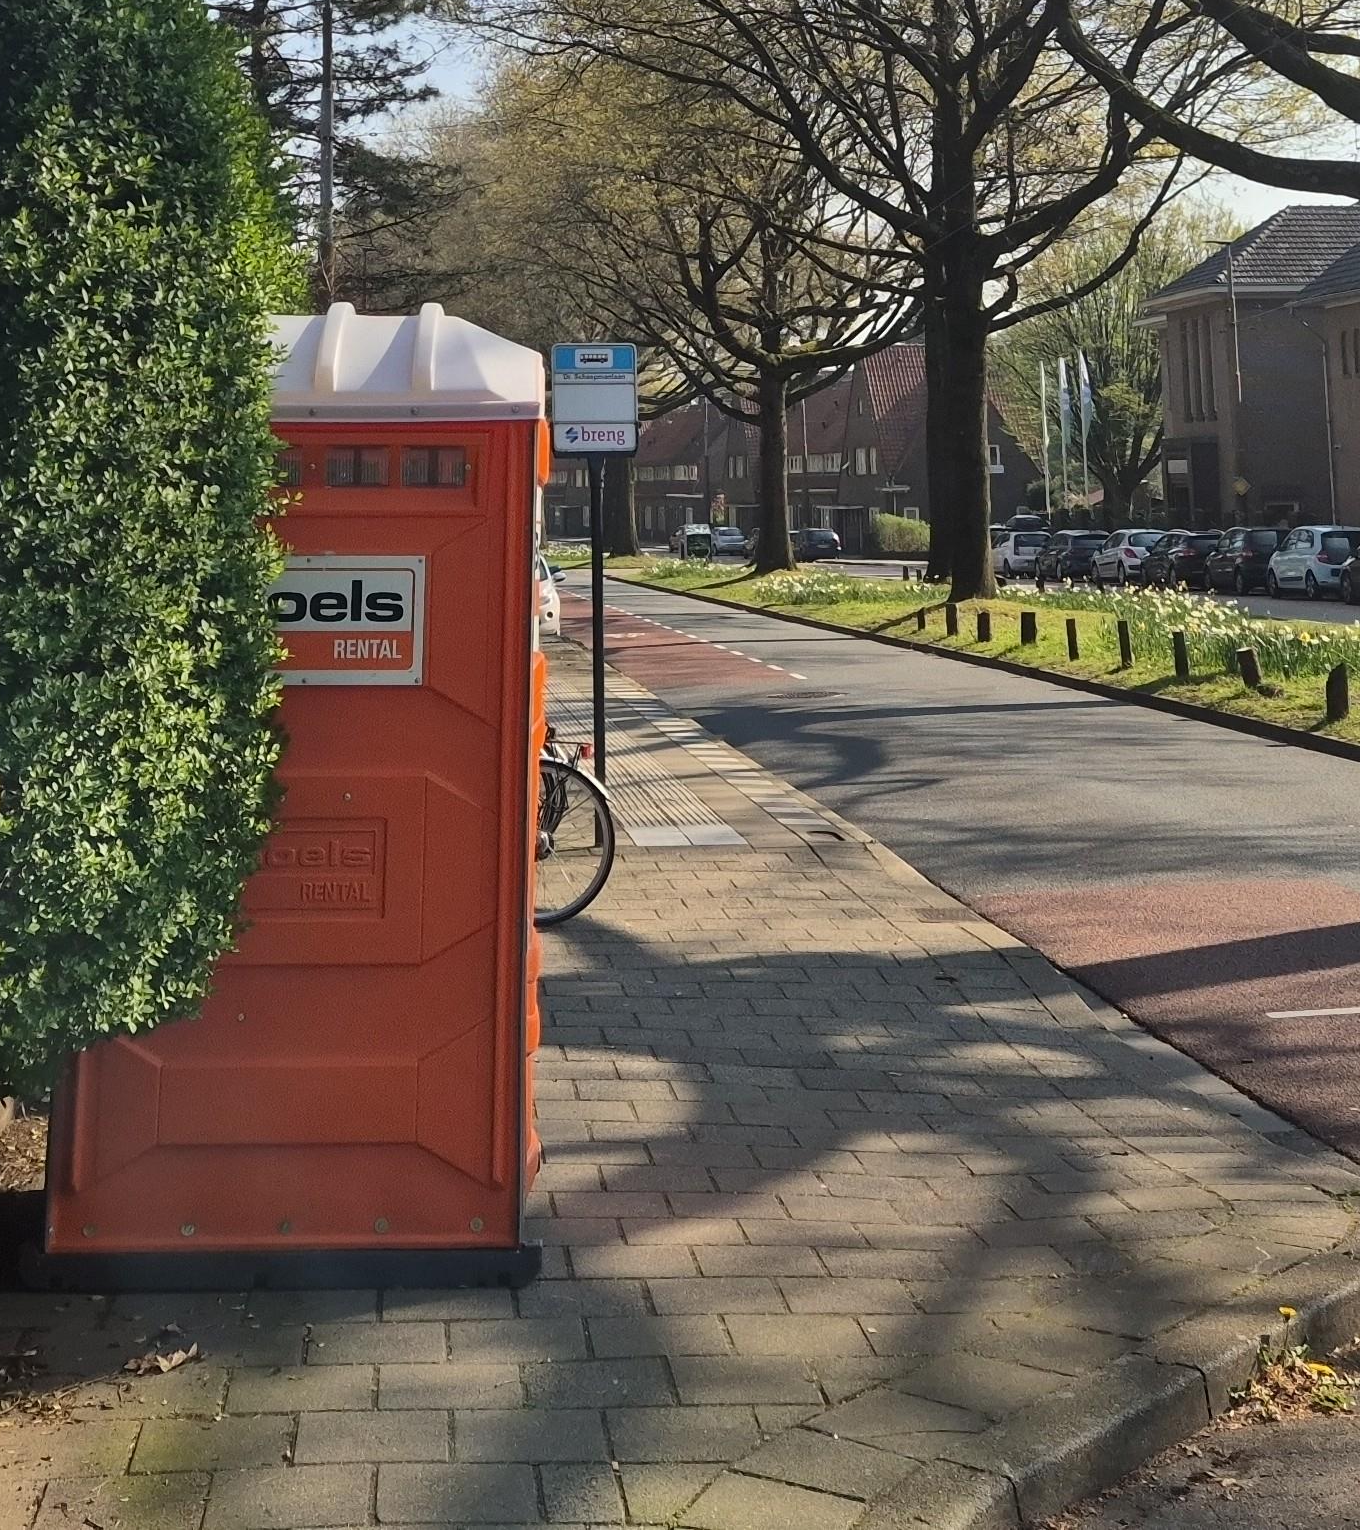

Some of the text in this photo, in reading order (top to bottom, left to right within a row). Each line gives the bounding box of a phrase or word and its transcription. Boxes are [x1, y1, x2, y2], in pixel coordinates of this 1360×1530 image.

[581, 426, 625, 445] breng
[268, 580, 404, 622] oels
[333, 639, 403, 659] RENTAL
[263, 840, 372, 868] oels
[300, 882, 371, 902] RENTAL
